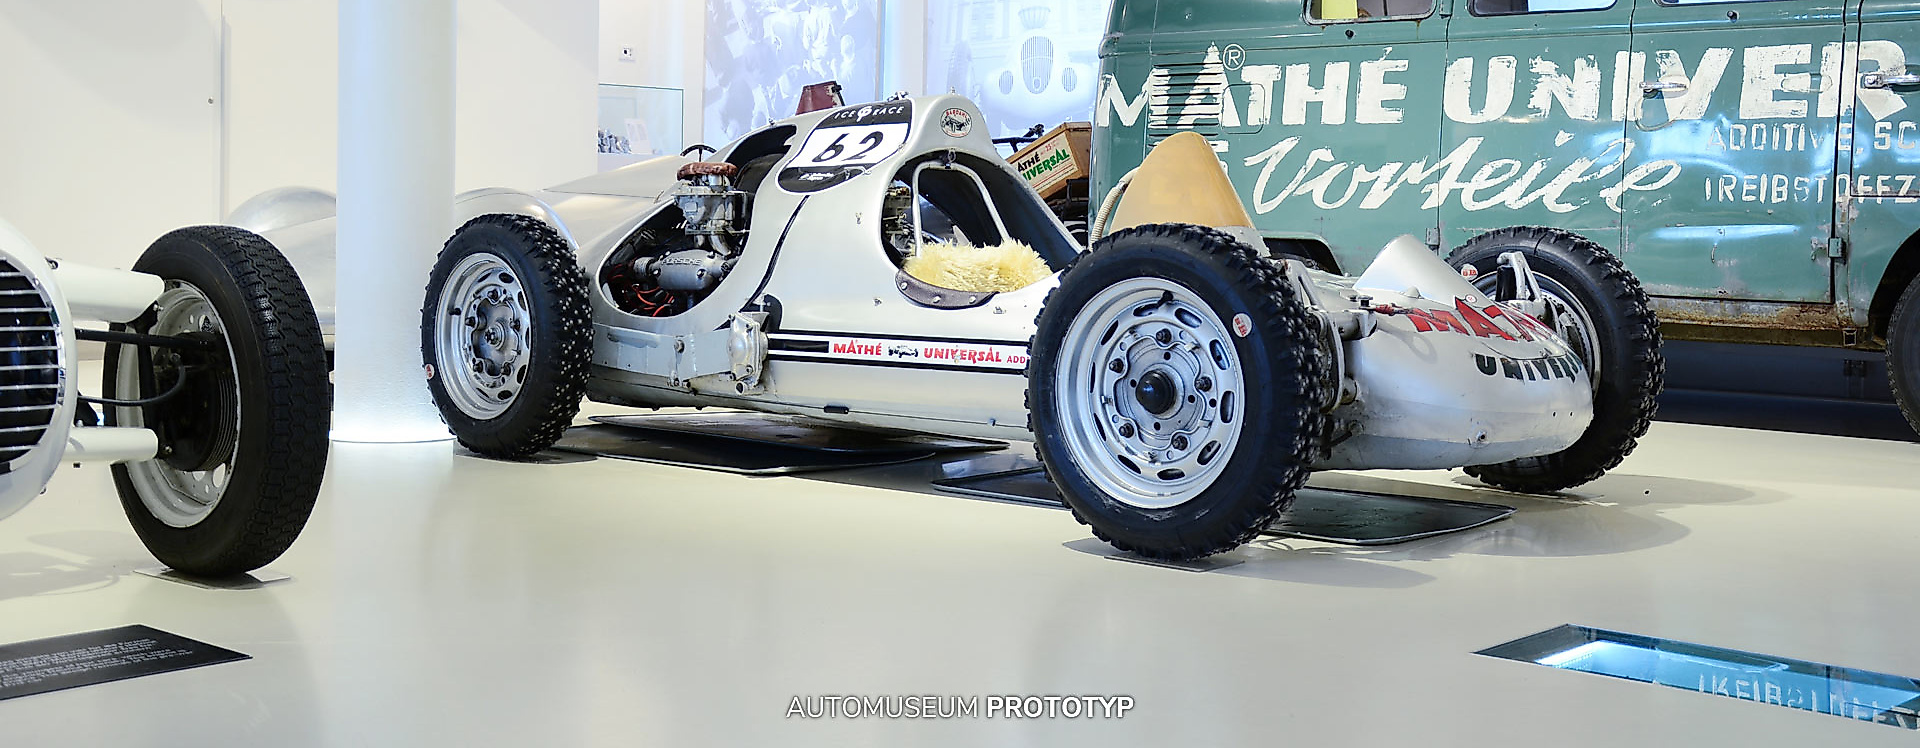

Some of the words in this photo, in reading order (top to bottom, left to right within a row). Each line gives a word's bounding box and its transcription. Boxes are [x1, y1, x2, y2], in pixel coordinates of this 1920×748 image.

[1098, 41, 1409, 129] MATHÉ
[834, 110, 857, 119] ICE
[872, 106, 905, 116] RACE
[812, 131, 884, 162] 62
[1244, 130, 1682, 214] Vorteile
[833, 340, 882, 356] MATHÉ
[924, 347, 1002, 364] UNIVERSAL
[1006, 355, 1029, 364] ADD
